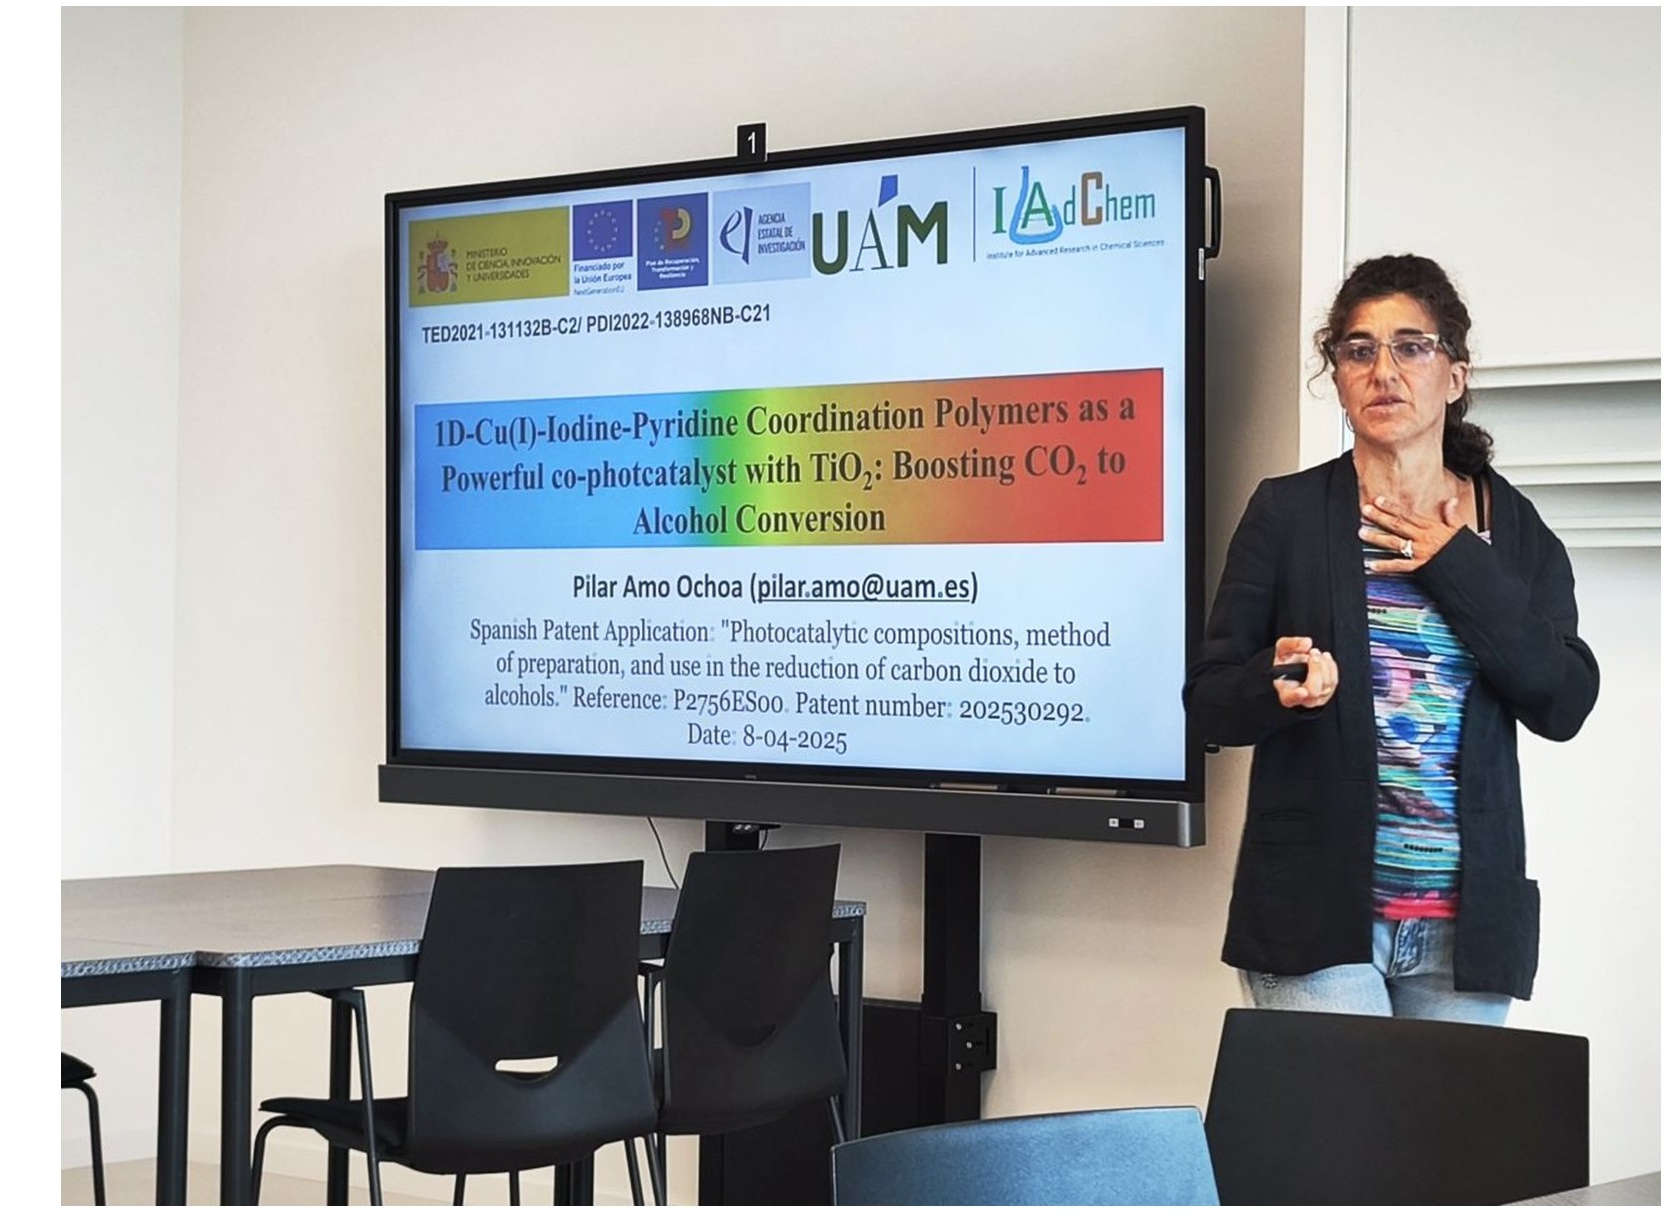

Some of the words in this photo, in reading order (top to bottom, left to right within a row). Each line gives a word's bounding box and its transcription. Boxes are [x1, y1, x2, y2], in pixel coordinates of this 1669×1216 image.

[748, 132, 756, 154] 1
[758, 212, 786, 225] AGENCIA
[758, 227, 783, 240] ESTATAL
[784, 226, 793, 238] DE
[587, 304, 771, 333] PDI2022-138968NB-C21
[435, 408, 738, 451] 1D-Cu(I)-Iodine-Pyridine
[747, 400, 924, 436] Coordination
[934, 397, 1069, 435] Polymers
[1079, 400, 1108, 422] as
[1120, 397, 1135, 420] a
[441, 462, 544, 493] Powerful
[551, 456, 737, 496] co-photcatalyst
[745, 454, 801, 484] with
[892, 448, 1016, 486] Boosting
[1097, 446, 1126, 475] to
[633, 505, 728, 535] Alcohol
[735, 502, 886, 534] Conversion
[573, 574, 618, 599] Pilar
[622, 575, 671, 599] Amo
[676, 573, 743, 599] Ochoa
[750, 572, 979, 604] (pilar.amo@uam.es)
[470, 618, 536, 645] Spanish
[543, 619, 600, 641] Patent
[603, 618, 715, 647] Application:
[721, 618, 869, 649] "Photocatalytic
[874, 620, 1020, 650] compositions,
[1026, 621, 1111, 648] method
[496, 650, 515, 674] of
[517, 652, 626, 679] preparation,
[630, 653, 665, 677] and
[670, 659, 701, 677] use
[706, 654, 724, 677] in
[730, 654, 760, 679] the
[765, 655, 860, 681] reduction
[865, 656, 887, 682] of
[891, 656, 962, 683] carbon
[968, 657, 1048, 685] dioxide
[1054, 661, 1076, 685] to
[484, 684, 569, 708] alcohols."
[573, 686, 668, 711] Reference:
[795, 692, 860, 716] Patent
[865, 693, 953, 719] number:
[959, 700, 1091, 727] 202530292.
[687, 723, 737, 746] Date:
[742, 724, 848, 755] 8-04-2025
